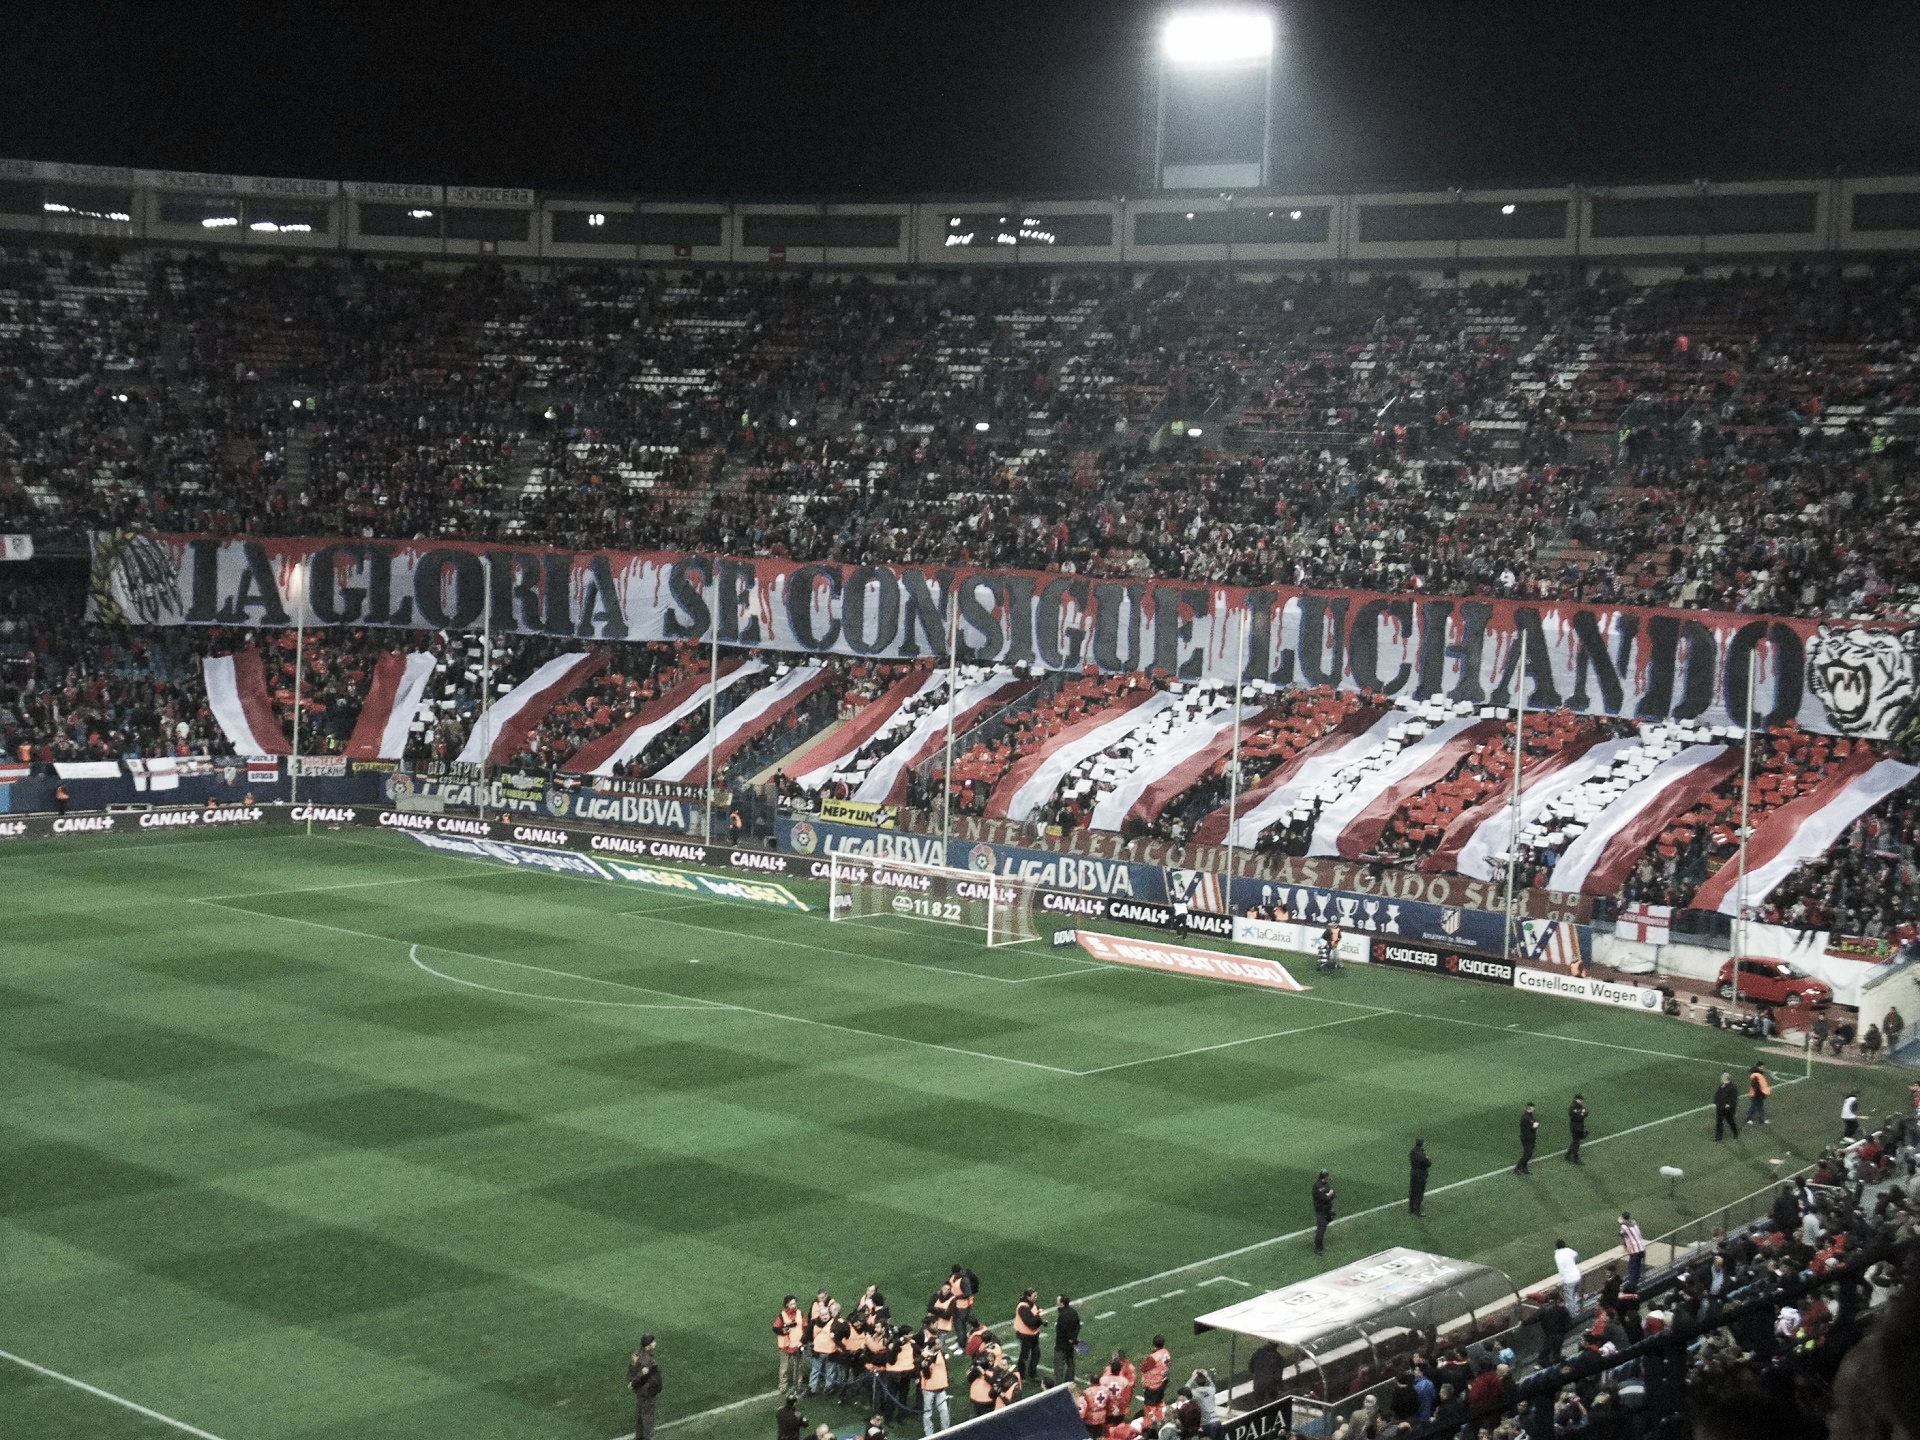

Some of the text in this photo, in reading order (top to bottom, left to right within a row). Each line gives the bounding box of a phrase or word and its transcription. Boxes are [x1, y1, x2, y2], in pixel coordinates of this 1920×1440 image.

[367, 184, 432, 199] KYOCERA
[465, 189, 527, 203] KYOCERA
[187, 538, 1806, 730] LA GLORIA SE CONSIGUE LUCHANDO
[53, 816, 114, 832] CANAL+
[139, 810, 200, 827] CANAL+
[203, 807, 263, 823] CANAL+
[291, 807, 355, 821] CANAL+
[379, 812, 433, 830] CANAL+
[436, 817, 491, 836] CANAL+
[513, 826, 568, 845] CANAL+
[590, 835, 647, 854] CANAL+
[650, 842, 706, 861] CANAL+
[730, 851, 787, 872] CANAL+
[810, 862, 868, 882] CANAL+
[872, 870, 931, 891] CANAL+
[956, 882, 1017, 903] CANAL+
[1332, 864, 1450, 904] FONDO
[1043, 893, 1105, 915] CANAL+
[1109, 902, 1170, 925] CANAL+
[1185, 913, 1233, 935] ANAL+
[1053, 930, 1077, 945] BBVA
[1386, 946, 1438, 966] KYOCERA
[1210, 956, 1283, 983] TOLEDO
[1458, 958, 1512, 979] KYOCERA
[1519, 972, 1638, 1003] Castellana Wagen
